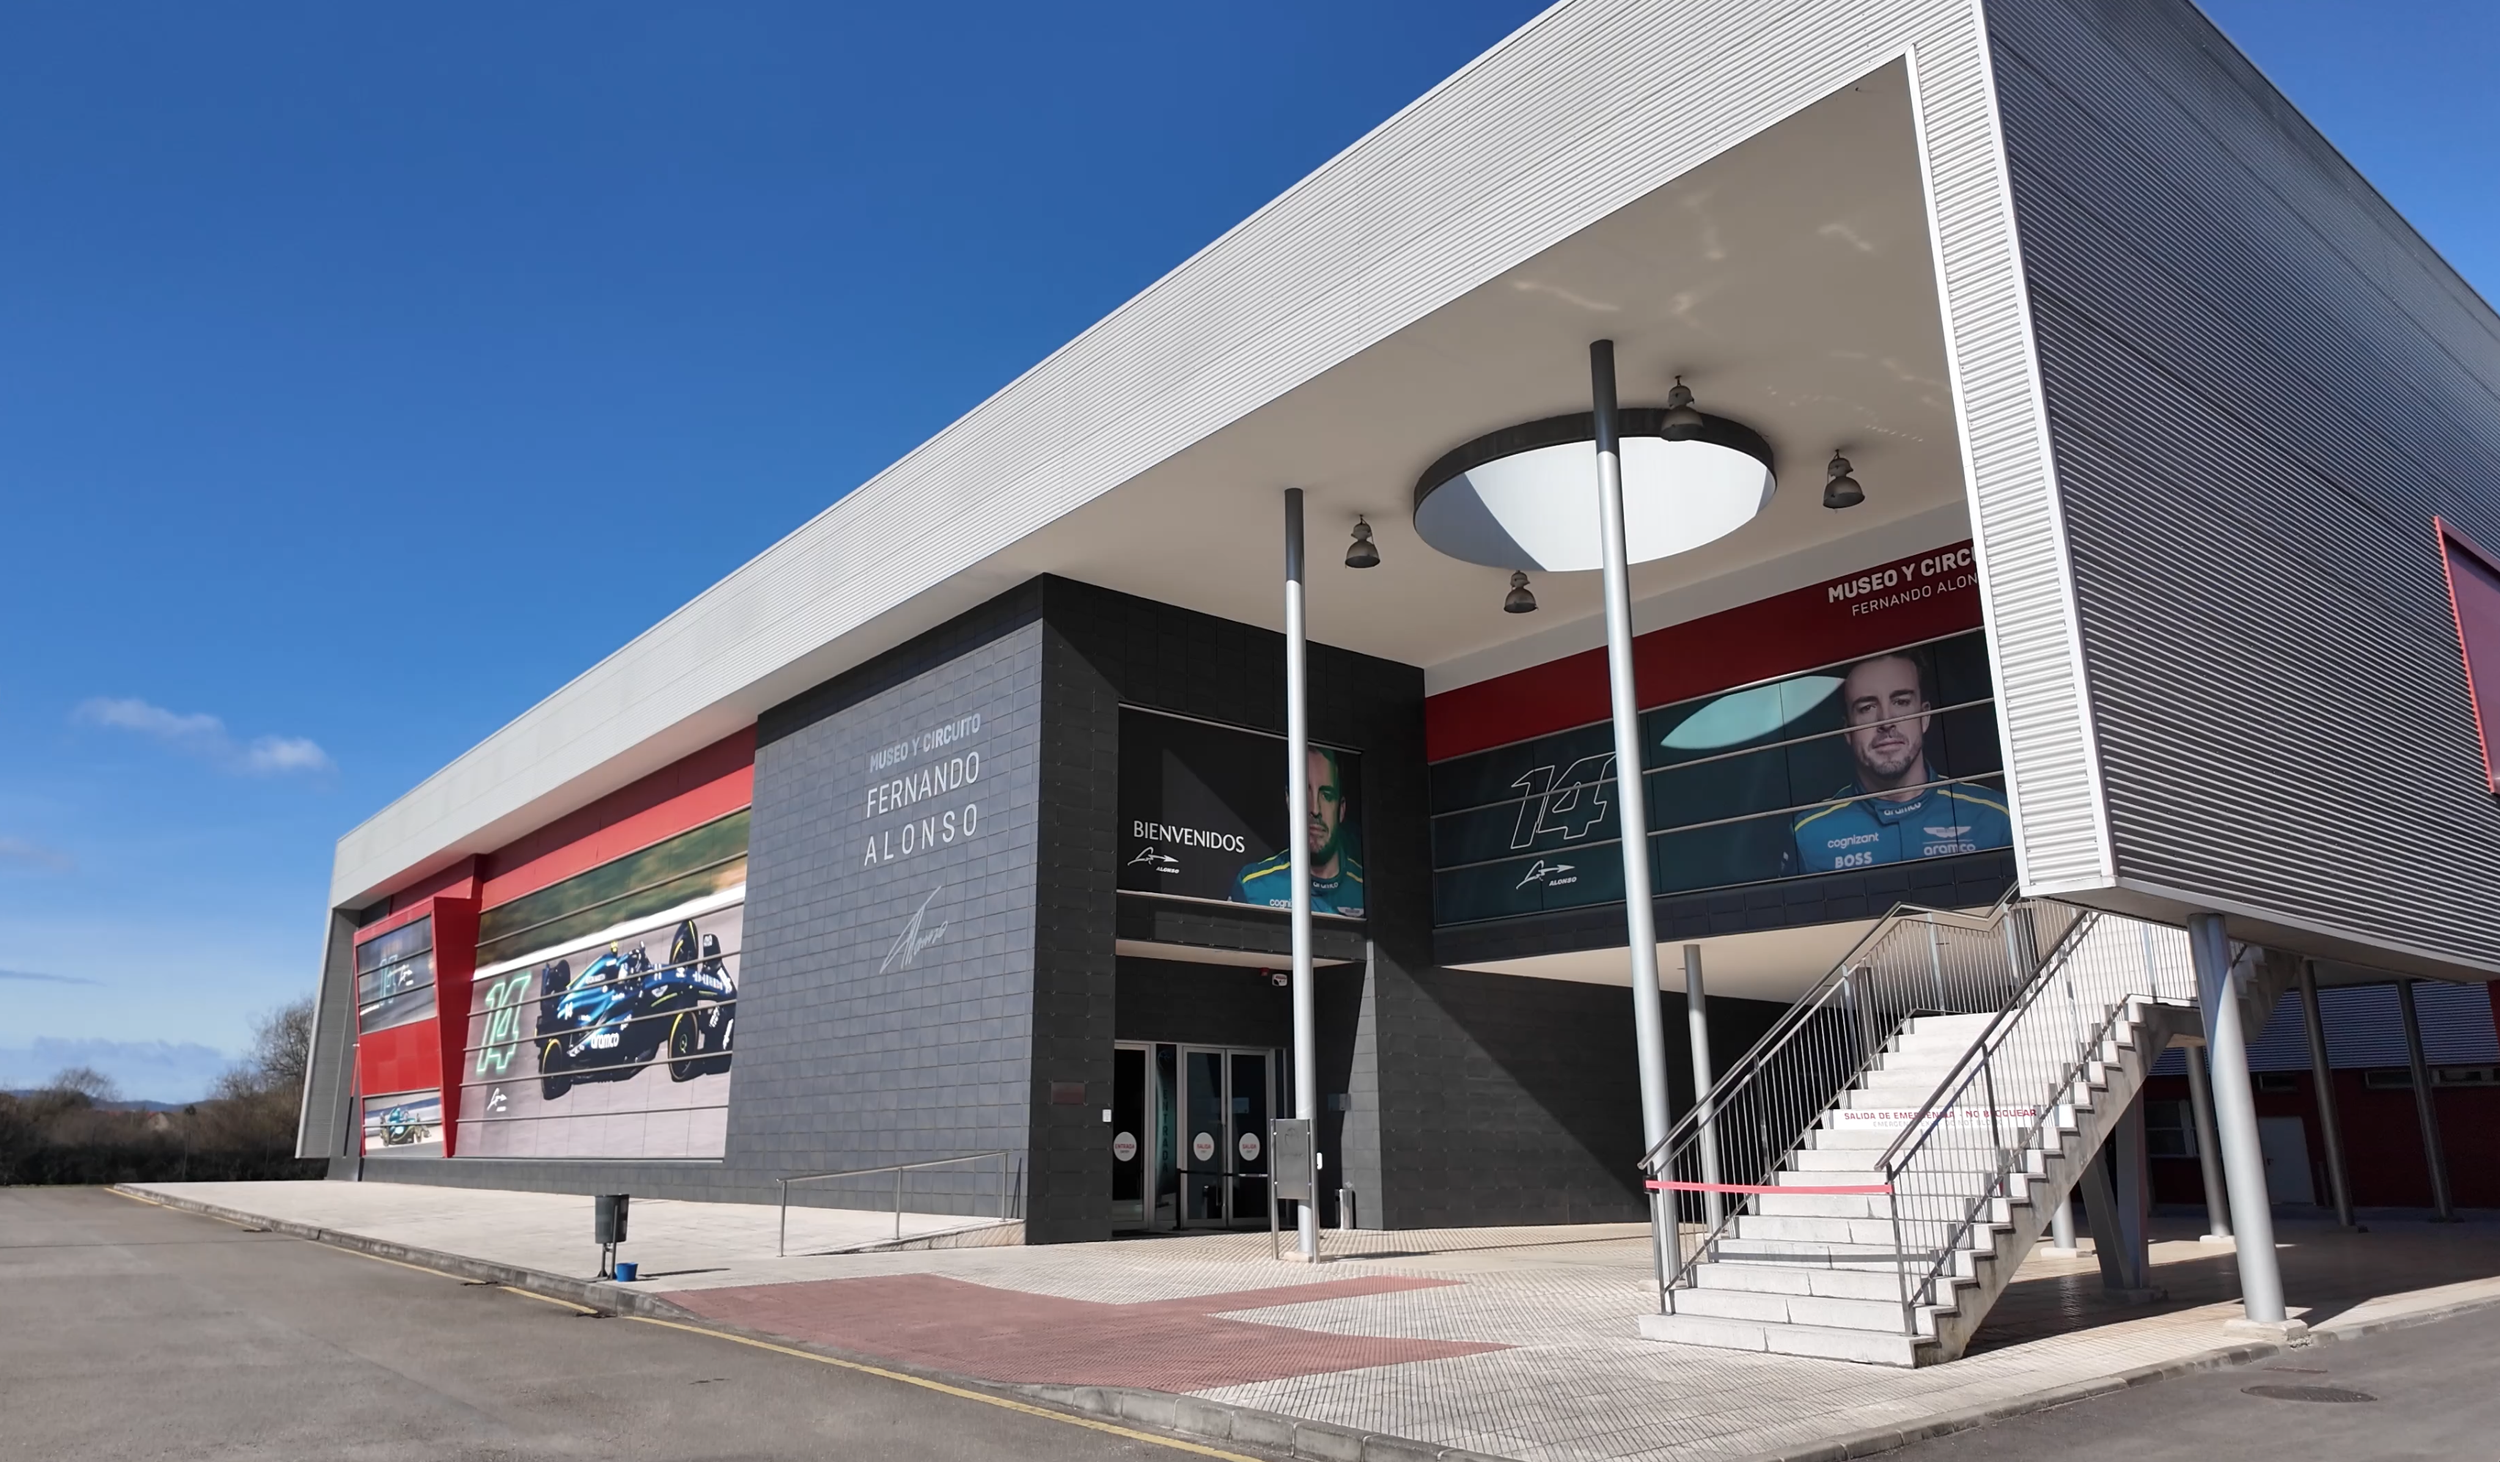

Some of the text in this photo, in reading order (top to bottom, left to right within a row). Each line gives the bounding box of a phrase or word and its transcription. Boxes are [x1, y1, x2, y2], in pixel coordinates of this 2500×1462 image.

[1828, 546, 1976, 603] MUSEO Y CIRC
[1852, 572, 1978, 616] FERNANDO ALON
[869, 713, 982, 773] MUSEO Y CIRCUITO
[866, 751, 980, 818] FERNANDO
[1511, 751, 1618, 849] 14
[864, 803, 978, 867] ALONSO
[1134, 820, 1245, 853] BIENVENIDOS
[1827, 832, 1880, 849] cognizant
[1835, 851, 1873, 869] BOSS
[1923, 843, 1976, 856] aramco
[1156, 866, 1180, 874] ALONSO
[1549, 876, 1578, 887] ALONSO
[1269, 899, 1292, 909] cogni
[476, 974, 532, 1073] 14
[590, 1032, 619, 1050] aramco
[1844, 1112, 1876, 1120] SALIDA
[1878, 1111, 1891, 1120] DE
[1965, 1110, 1980, 1118] NO
[1983, 1109, 2037, 1118] BOQUEAR
